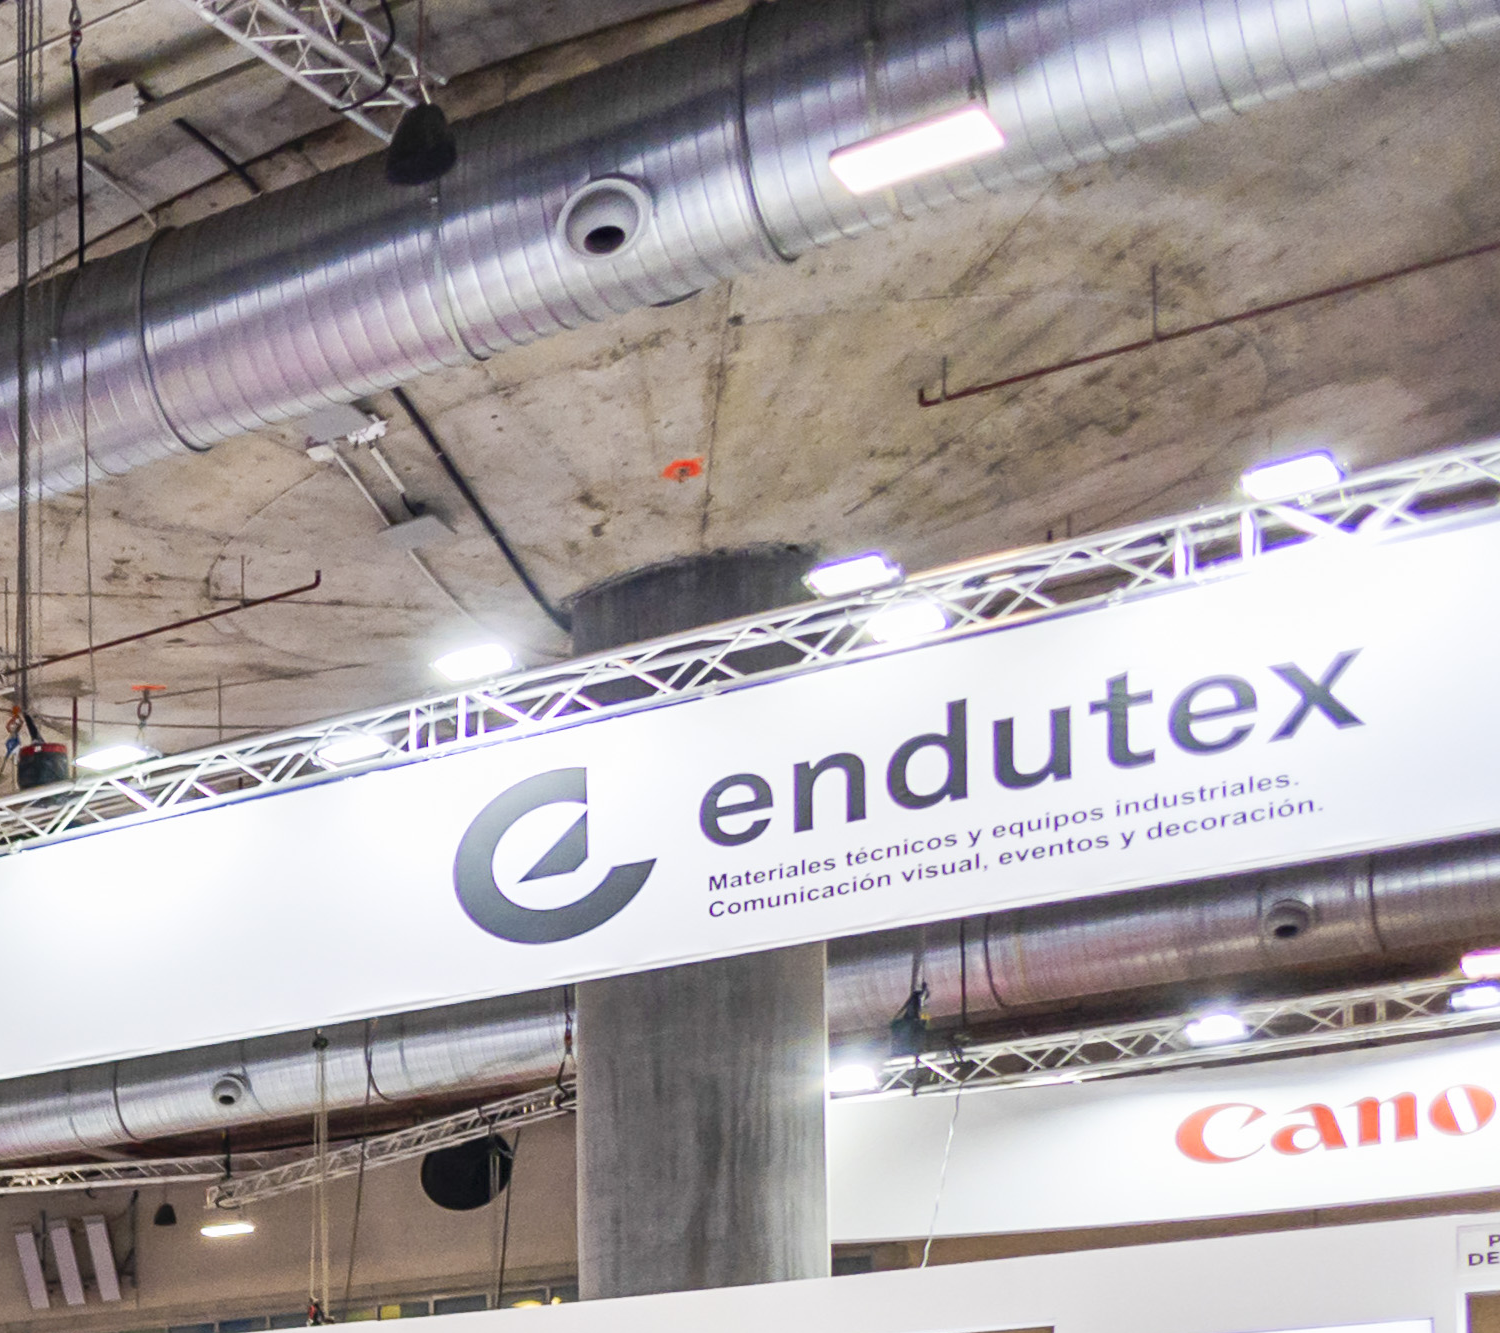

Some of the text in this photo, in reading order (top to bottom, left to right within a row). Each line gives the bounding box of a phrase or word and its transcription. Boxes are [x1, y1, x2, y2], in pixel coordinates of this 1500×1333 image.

[699, 647, 1366, 848] endutex
[708, 773, 1301, 892] Materiales técnicos y equipos industriales.
[708, 797, 1326, 918] Comunicación visual, eventos y decoración.
